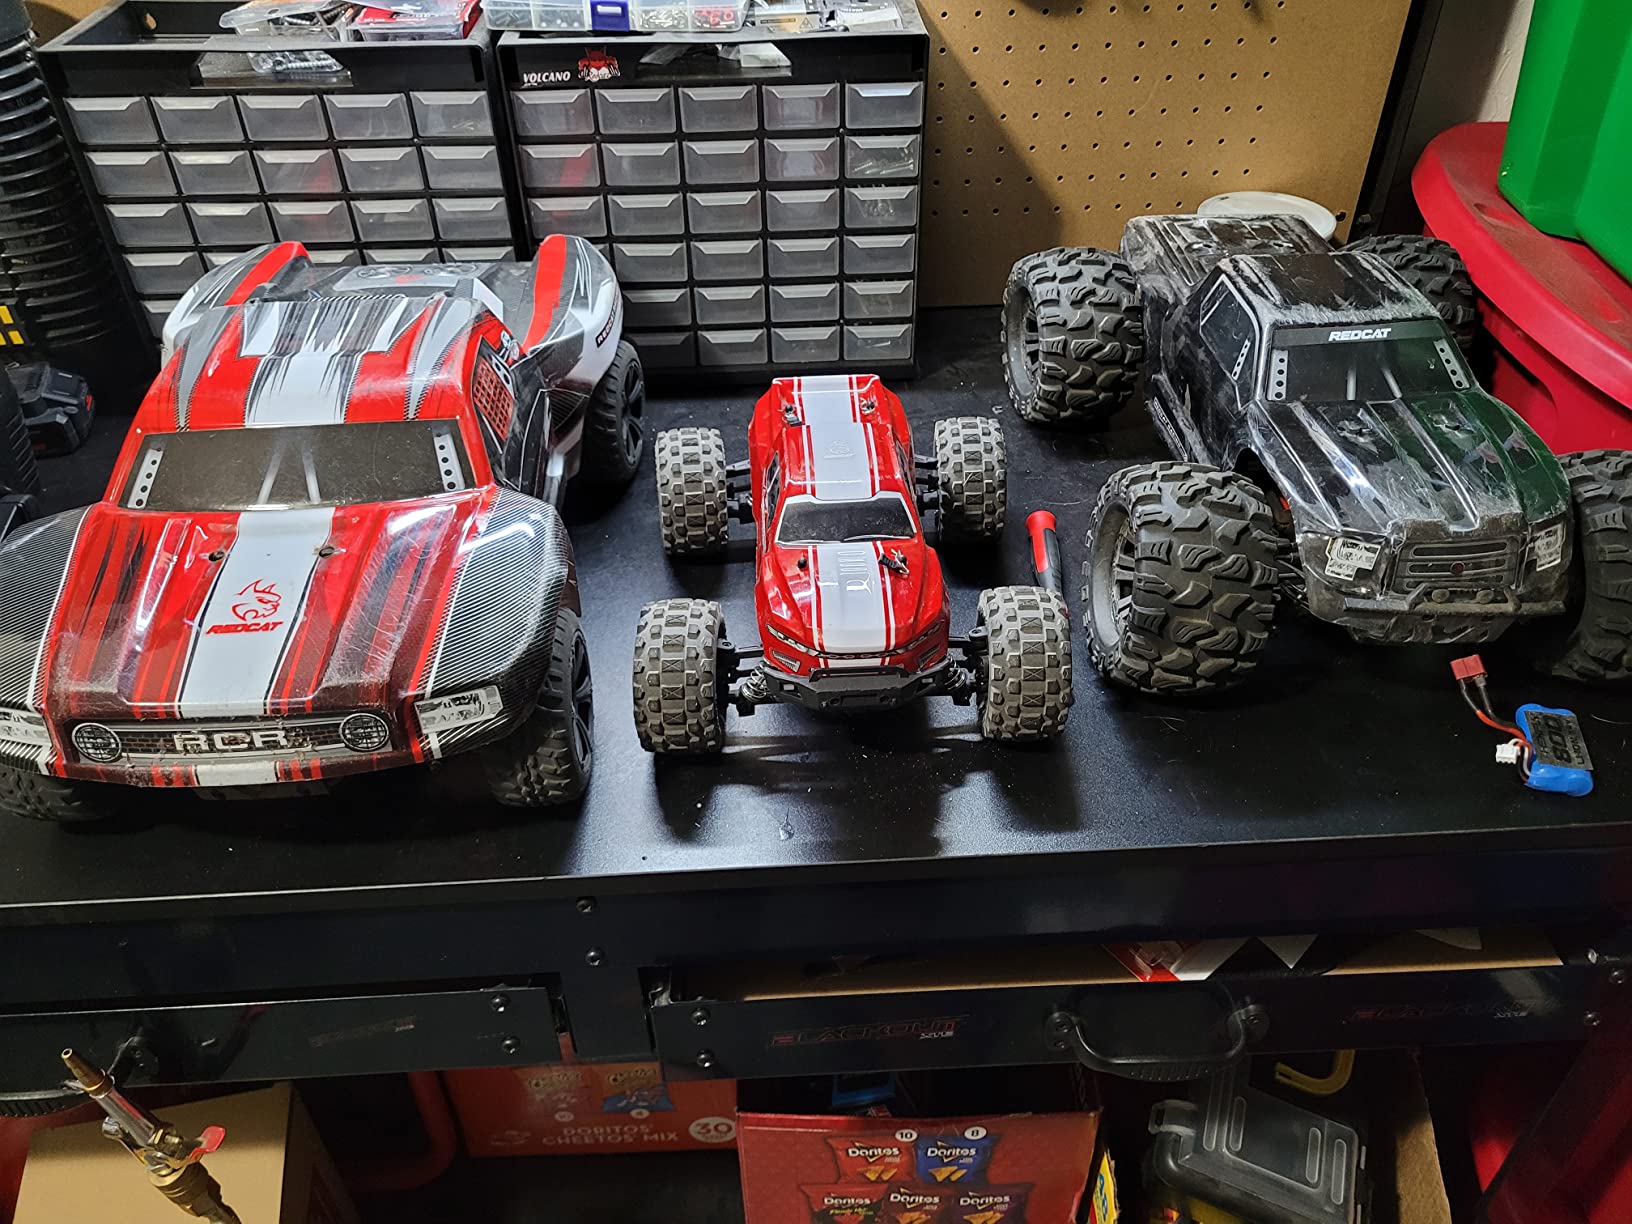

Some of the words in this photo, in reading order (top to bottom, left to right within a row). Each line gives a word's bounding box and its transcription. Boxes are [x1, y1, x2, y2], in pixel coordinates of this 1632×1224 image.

[523, 71, 571, 83] VOLCANO
[1328, 327, 1392, 342] REDCAT
[205, 621, 284, 635] REDCAT
[173, 730, 288, 751] RCR
[1544, 715, 1572, 762] 800
[563, 1125, 650, 1135] DORITOS
[696, 1122, 732, 1135] 30
[899, 1130, 914, 1140] 10
[542, 1134, 635, 1146] CHEETOS
[643, 1132, 679, 1142] MIX
[847, 1146, 901, 1158] Doritos
[926, 1145, 977, 1158] Doritos
[823, 1196, 871, 1206] Doritos
[889, 1192, 941, 1205] Doritos
[959, 1194, 1011, 1207] Doritos
